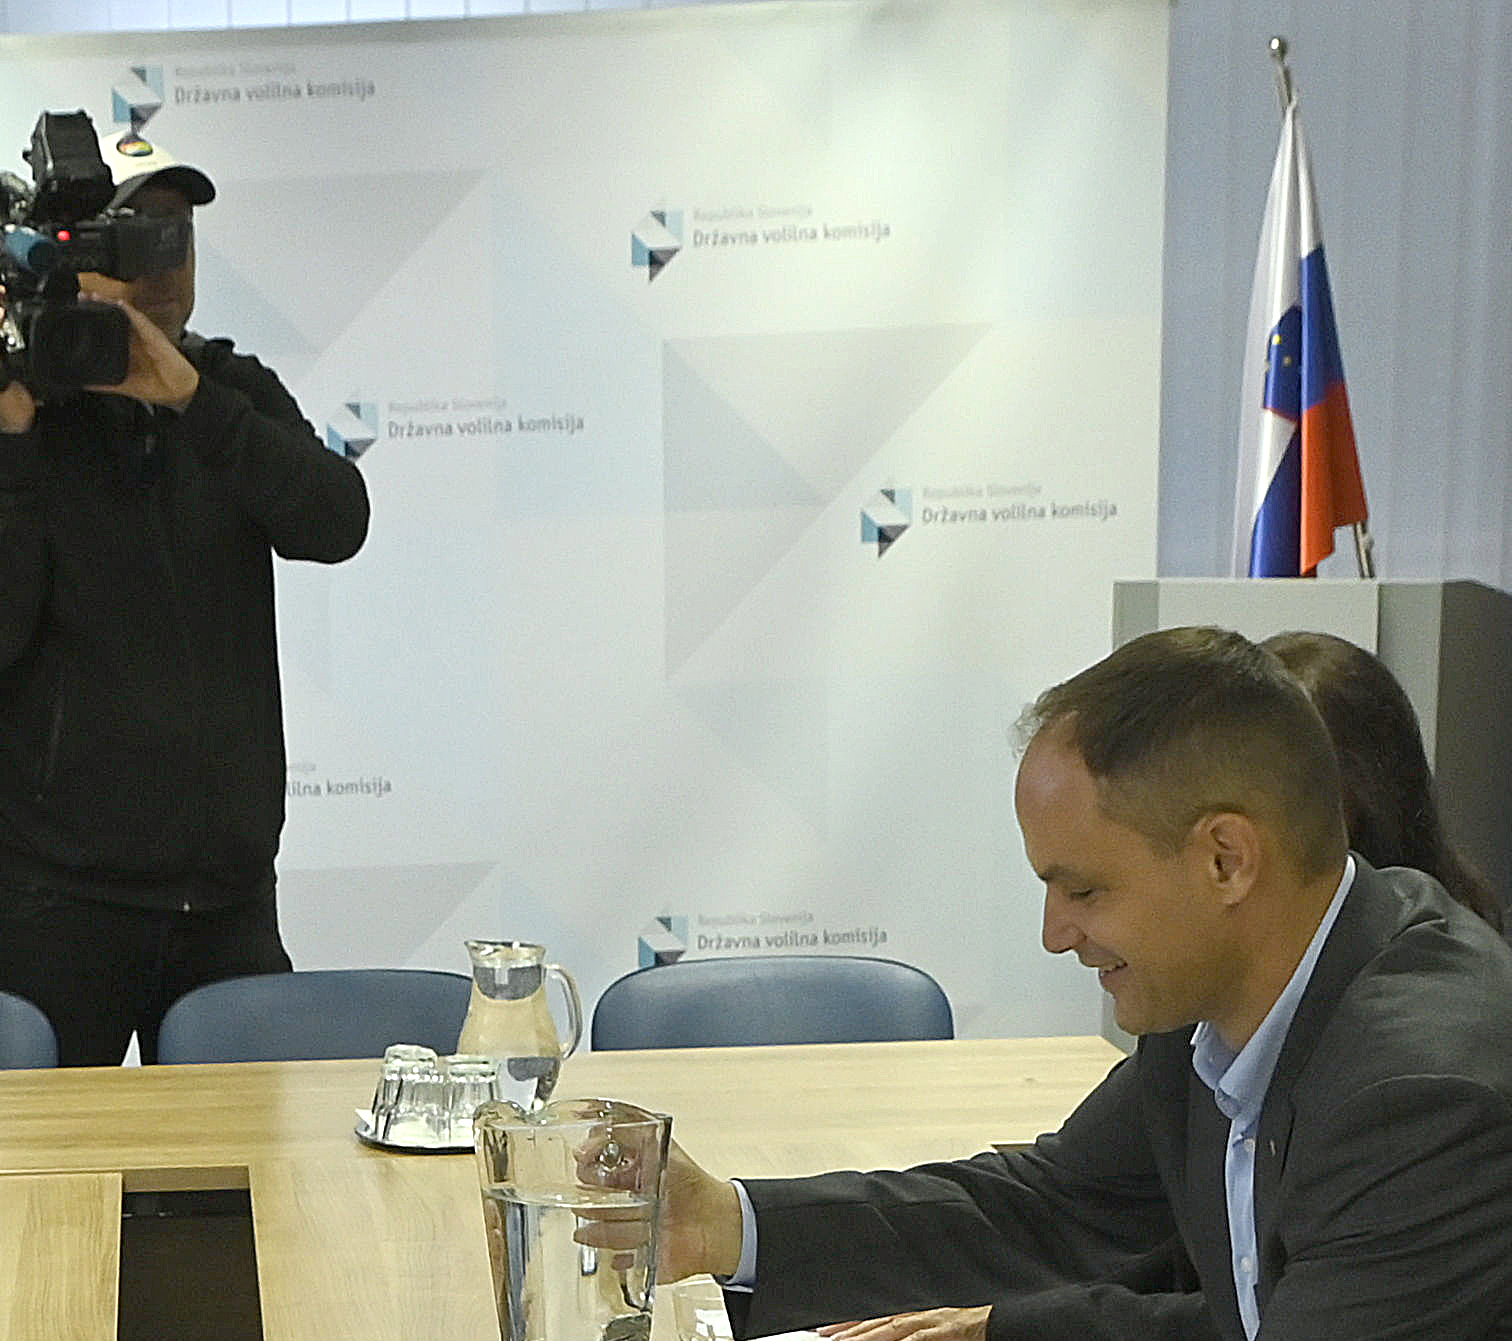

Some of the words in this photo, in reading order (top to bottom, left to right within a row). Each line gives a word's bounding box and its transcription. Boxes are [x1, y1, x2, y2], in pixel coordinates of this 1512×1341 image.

[823, 219, 891, 243] komisija
[517, 412, 585, 435] komisija
[1051, 499, 1118, 521] komisija
[327, 776, 392, 798] komisija
[697, 934, 760, 950] Državna
[764, 930, 818, 948] volilna
[823, 926, 888, 948] komisija
